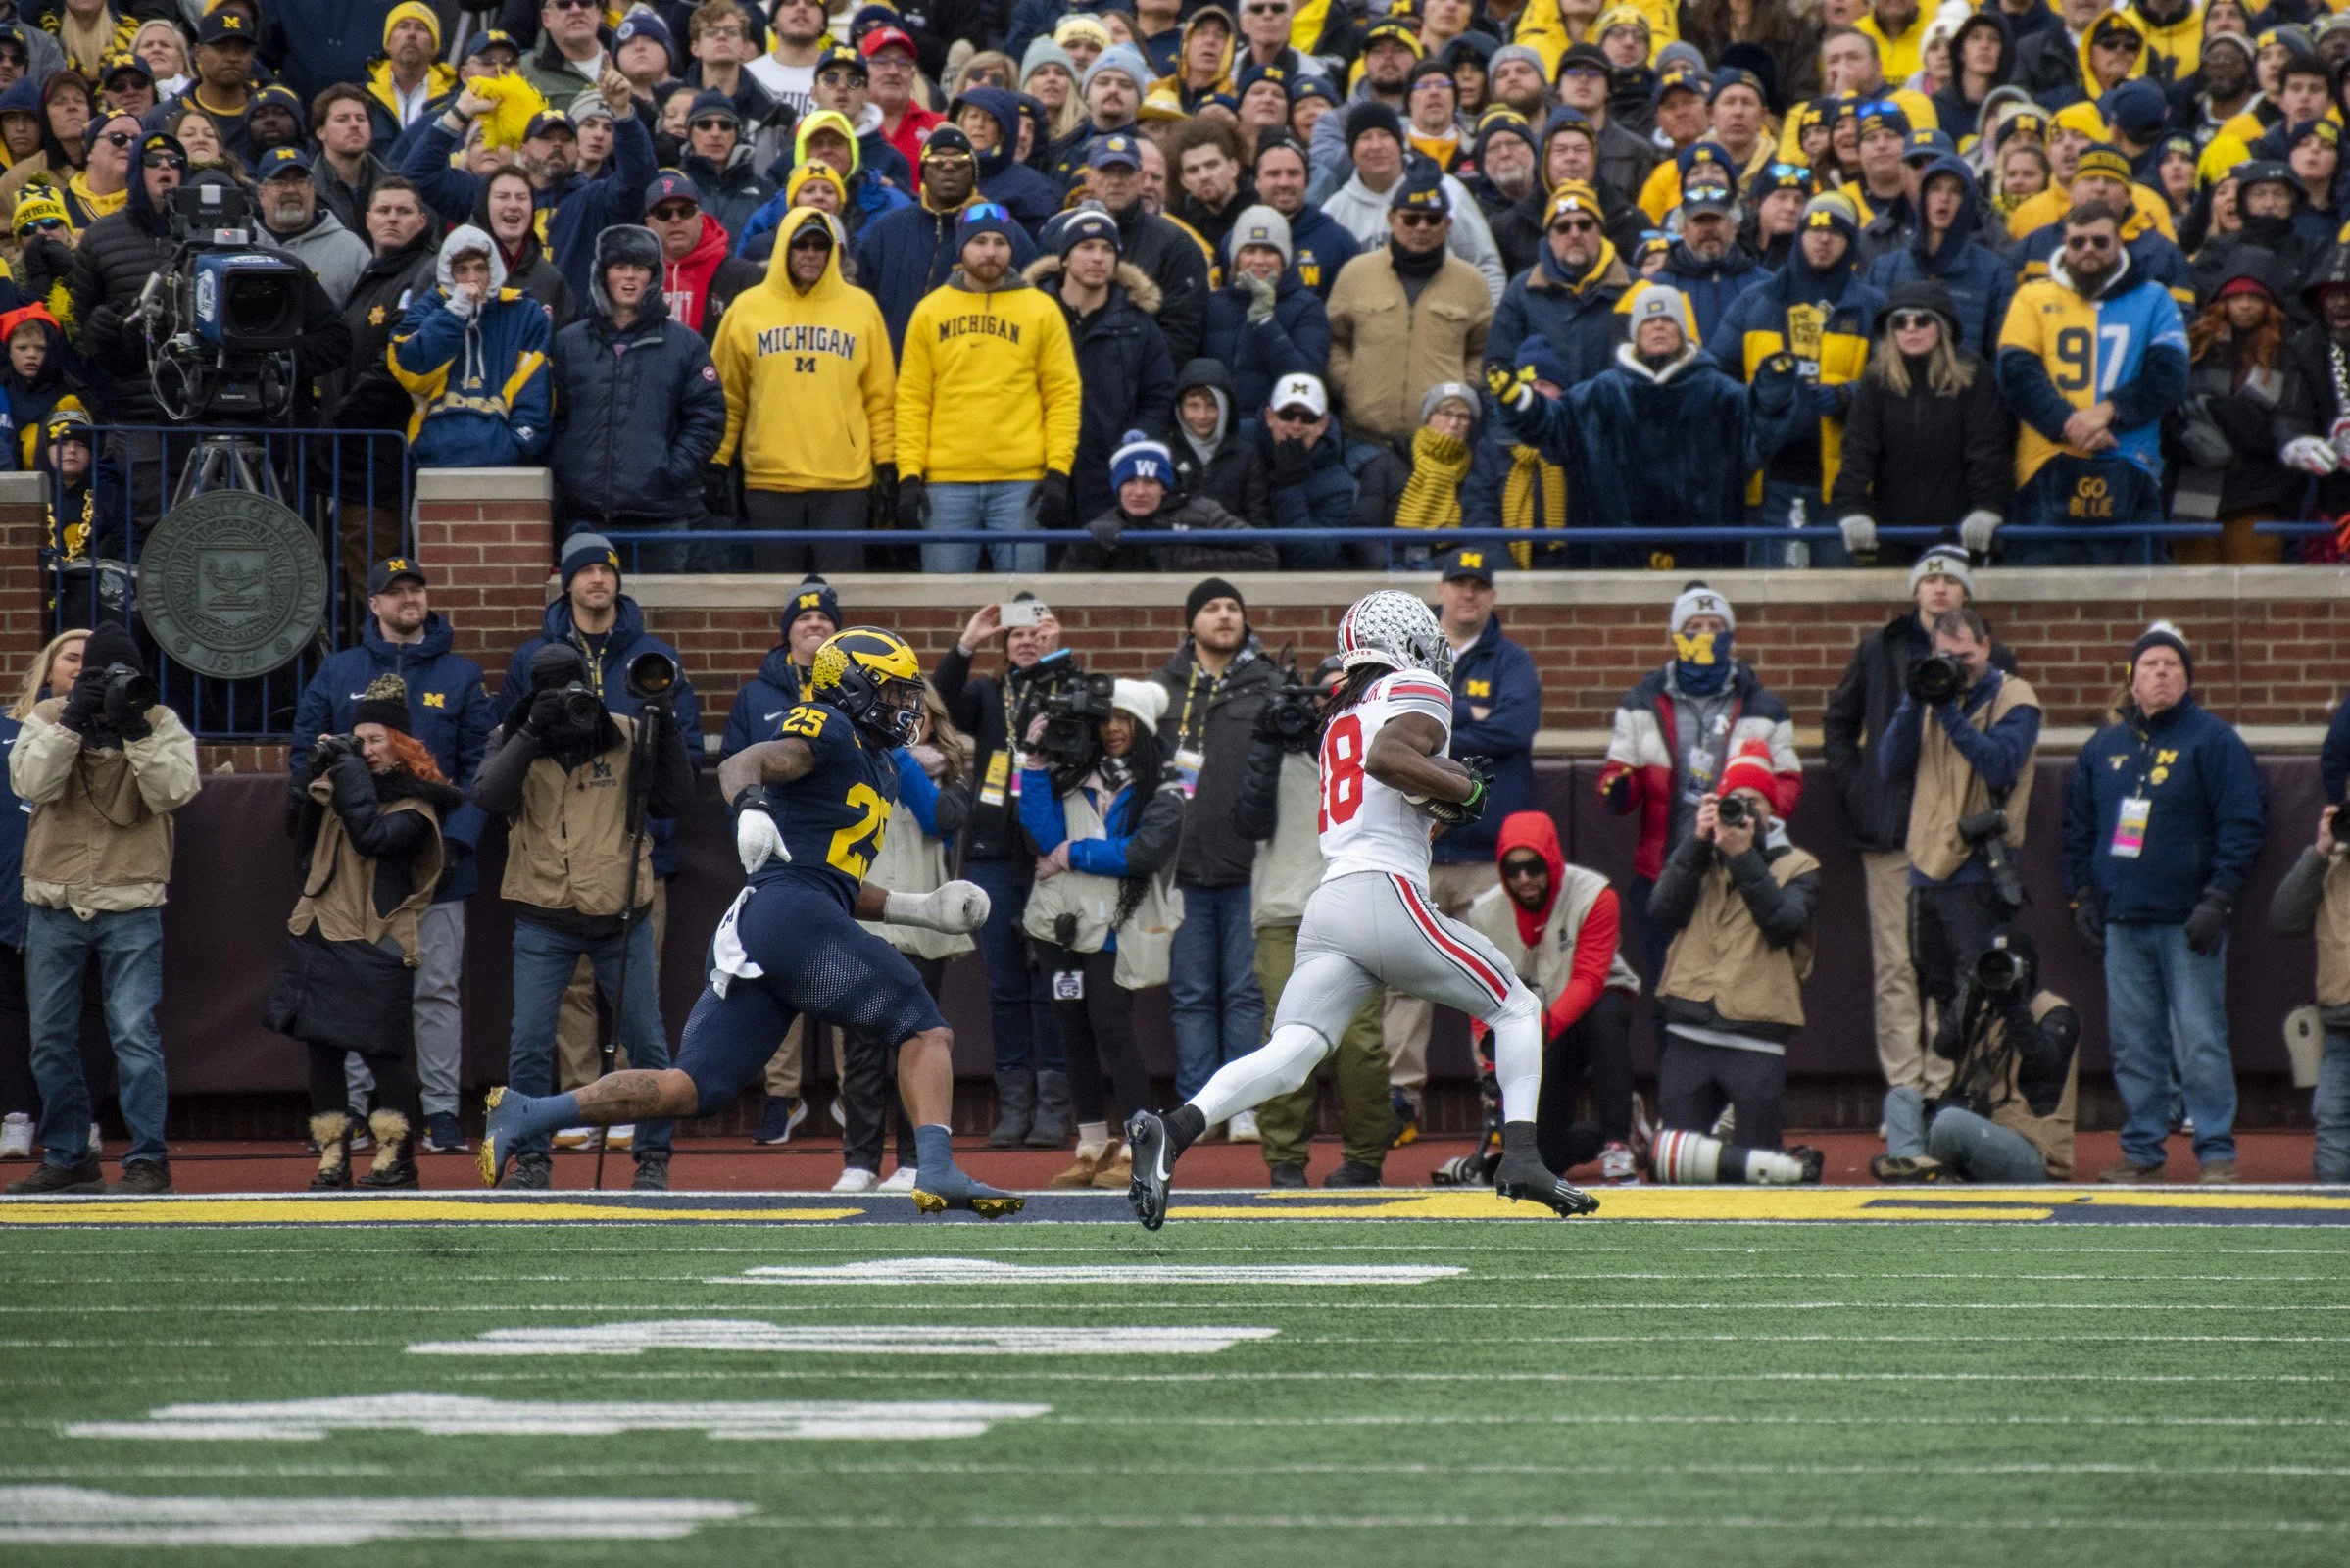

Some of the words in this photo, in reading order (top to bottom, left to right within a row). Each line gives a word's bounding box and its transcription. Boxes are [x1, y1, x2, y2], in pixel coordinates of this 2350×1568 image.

[223, 15, 240, 28] M
[113, 53, 134, 68] M
[835, 47, 856, 60] M
[808, 166, 825, 176] M
[1810, 211, 1830, 226] M
[1298, 266, 1321, 286] W
[938, 315, 1020, 344] MICHIGAN
[757, 324, 857, 361] MICHIGAN
[795, 357, 815, 372] M
[1292, 383, 1308, 394] M
[1135, 459, 1157, 477] W
[2077, 477, 2107, 499] GO
[388, 561, 408, 571] M
[1460, 552, 1483, 567] M
[799, 594, 819, 609] M
[1672, 633, 1714, 664] M
[1468, 680, 1490, 696] M
[423, 693, 445, 708] M
[782, 707, 828, 737] 25
[2156, 749, 2179, 764] M
[594, 763, 612, 778] M
